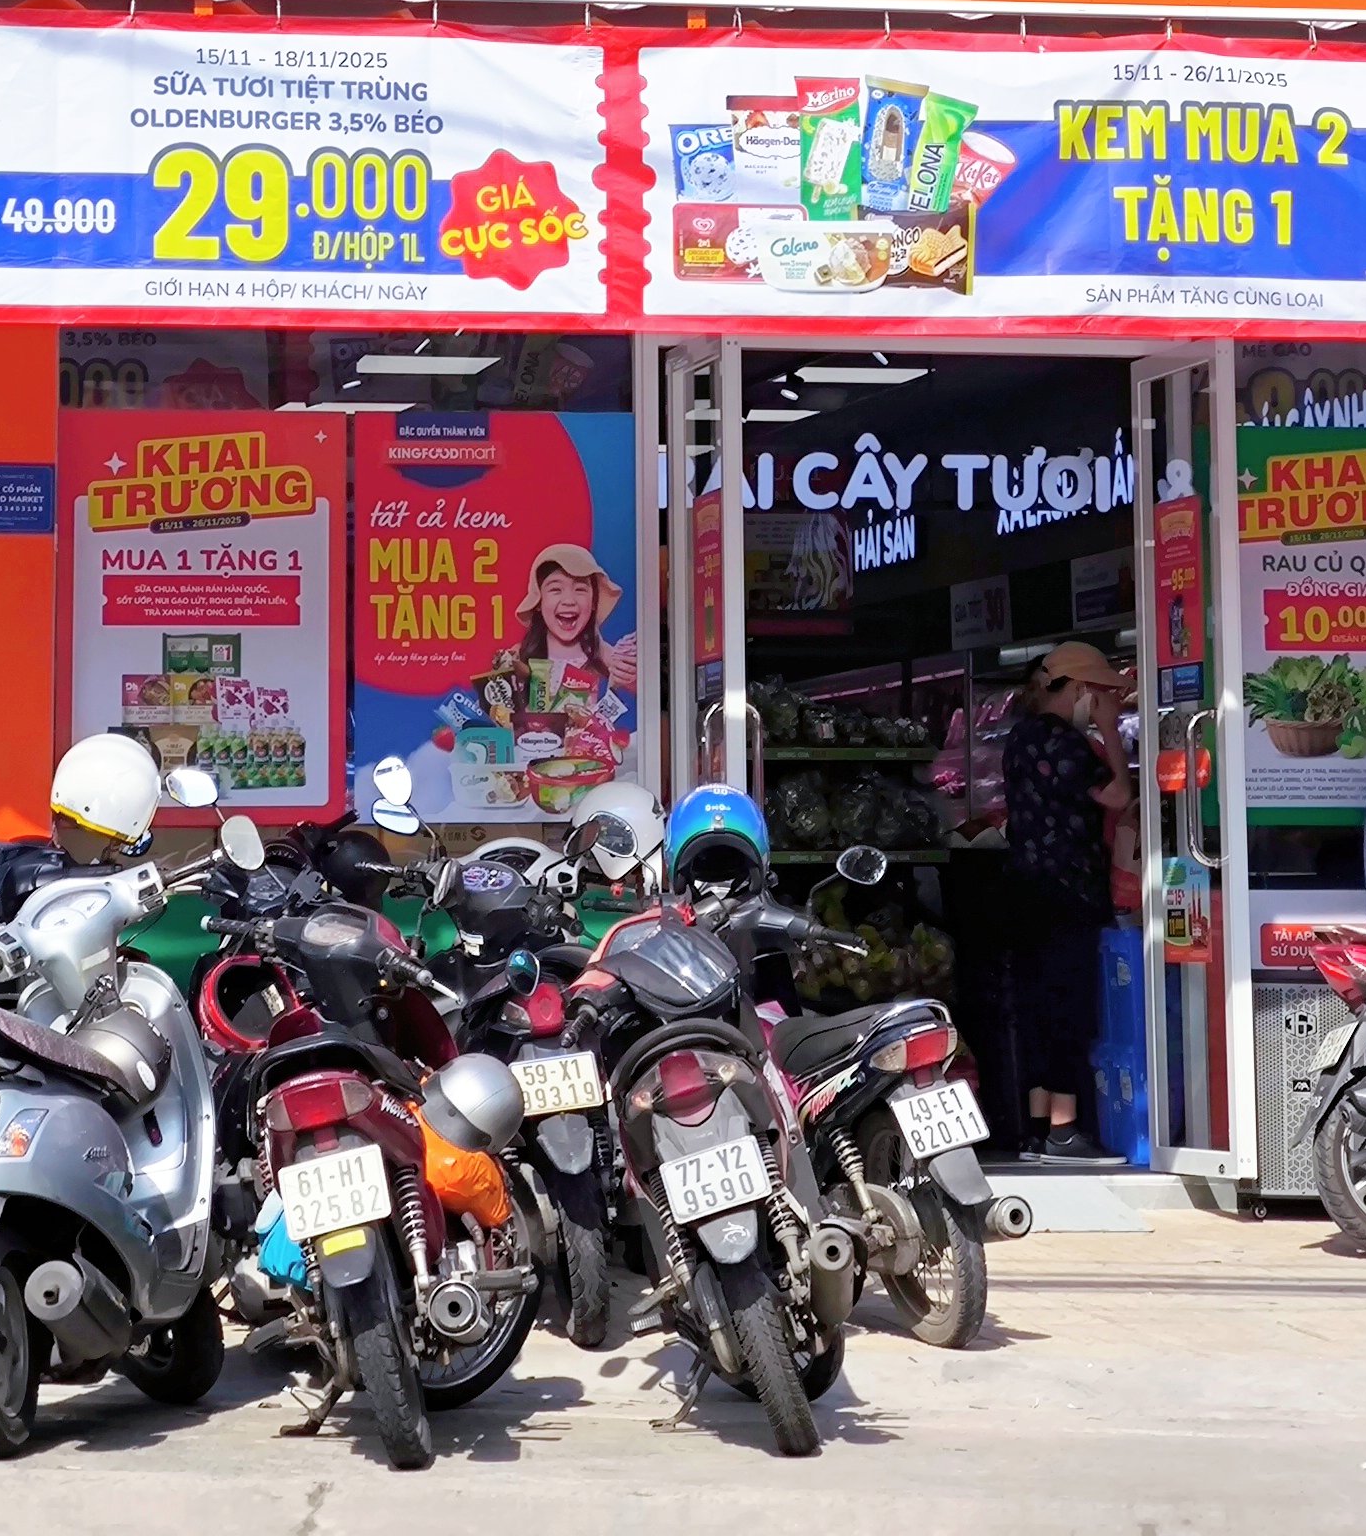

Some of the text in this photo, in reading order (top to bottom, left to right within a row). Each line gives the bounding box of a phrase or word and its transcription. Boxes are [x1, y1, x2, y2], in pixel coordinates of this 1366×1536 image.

[195, 47, 389, 70] 15/11 18/11/2025
[1112, 63, 1289, 89] 15/11 26/11/2025
[153, 70, 429, 106] SỮA TƯƠI TIỆT TRÙNG
[806, 85, 856, 109] Merino
[129, 107, 444, 136] OLDENBURGER 3,5% BÉO
[1058, 103, 1350, 166] KEM MUA 2
[677, 126, 734, 154] ORE
[745, 134, 801, 149] Häagen-Daz
[910, 143, 945, 212] ELONA
[957, 158, 999, 185] KitKat
[0, 147, 429, 263] 49.900 29.000
[475, 174, 536, 214] GIÁ
[440, 204, 589, 261] CỰC SỐC
[1113, 174, 1293, 263] TẶNG 1
[312, 225, 426, 270] Đ/HỘP 1L
[770, 236, 819, 257] Celano
[144, 277, 429, 303] GIỚI HẠN 4 HỘP/ KHÁCH/ NGÀY
[1085, 282, 1324, 311] SẢN PHẨM TẶNG CÙNG LOẠI
[141, 436, 262, 479] KHAI
[388, 444, 497, 461] KINGFOODmart
[792, 432, 929, 511] CÂY
[940, 445, 1112, 513] TƯƠI
[8, 495, 45, 503] MARKET
[92, 469, 309, 520] TRƯƠNG
[191, 515, 243, 529] 26/11/2025
[369, 496, 514, 530] tất cả kem
[101, 542, 304, 578] MUA 1 TẶNG 1
[368, 537, 499, 584] MUA 2
[1261, 554, 1307, 573] RAU
[1313, 549, 1344, 573] CỦ
[1285, 575, 1340, 598] ĐỒNG
[369, 586, 505, 649] TẶNG 1
[289, 1072, 325, 1087] HONDA
[522, 1058, 583, 1087] 59-X1
[907, 1087, 965, 1125] 49-E1
[910, 1110, 984, 1155] 820.11
[296, 1155, 366, 1200] 61-H1
[674, 1143, 747, 1188] 77-Y2
[292, 1184, 384, 1234] 325.82
[684, 1171, 756, 1214] 9590
